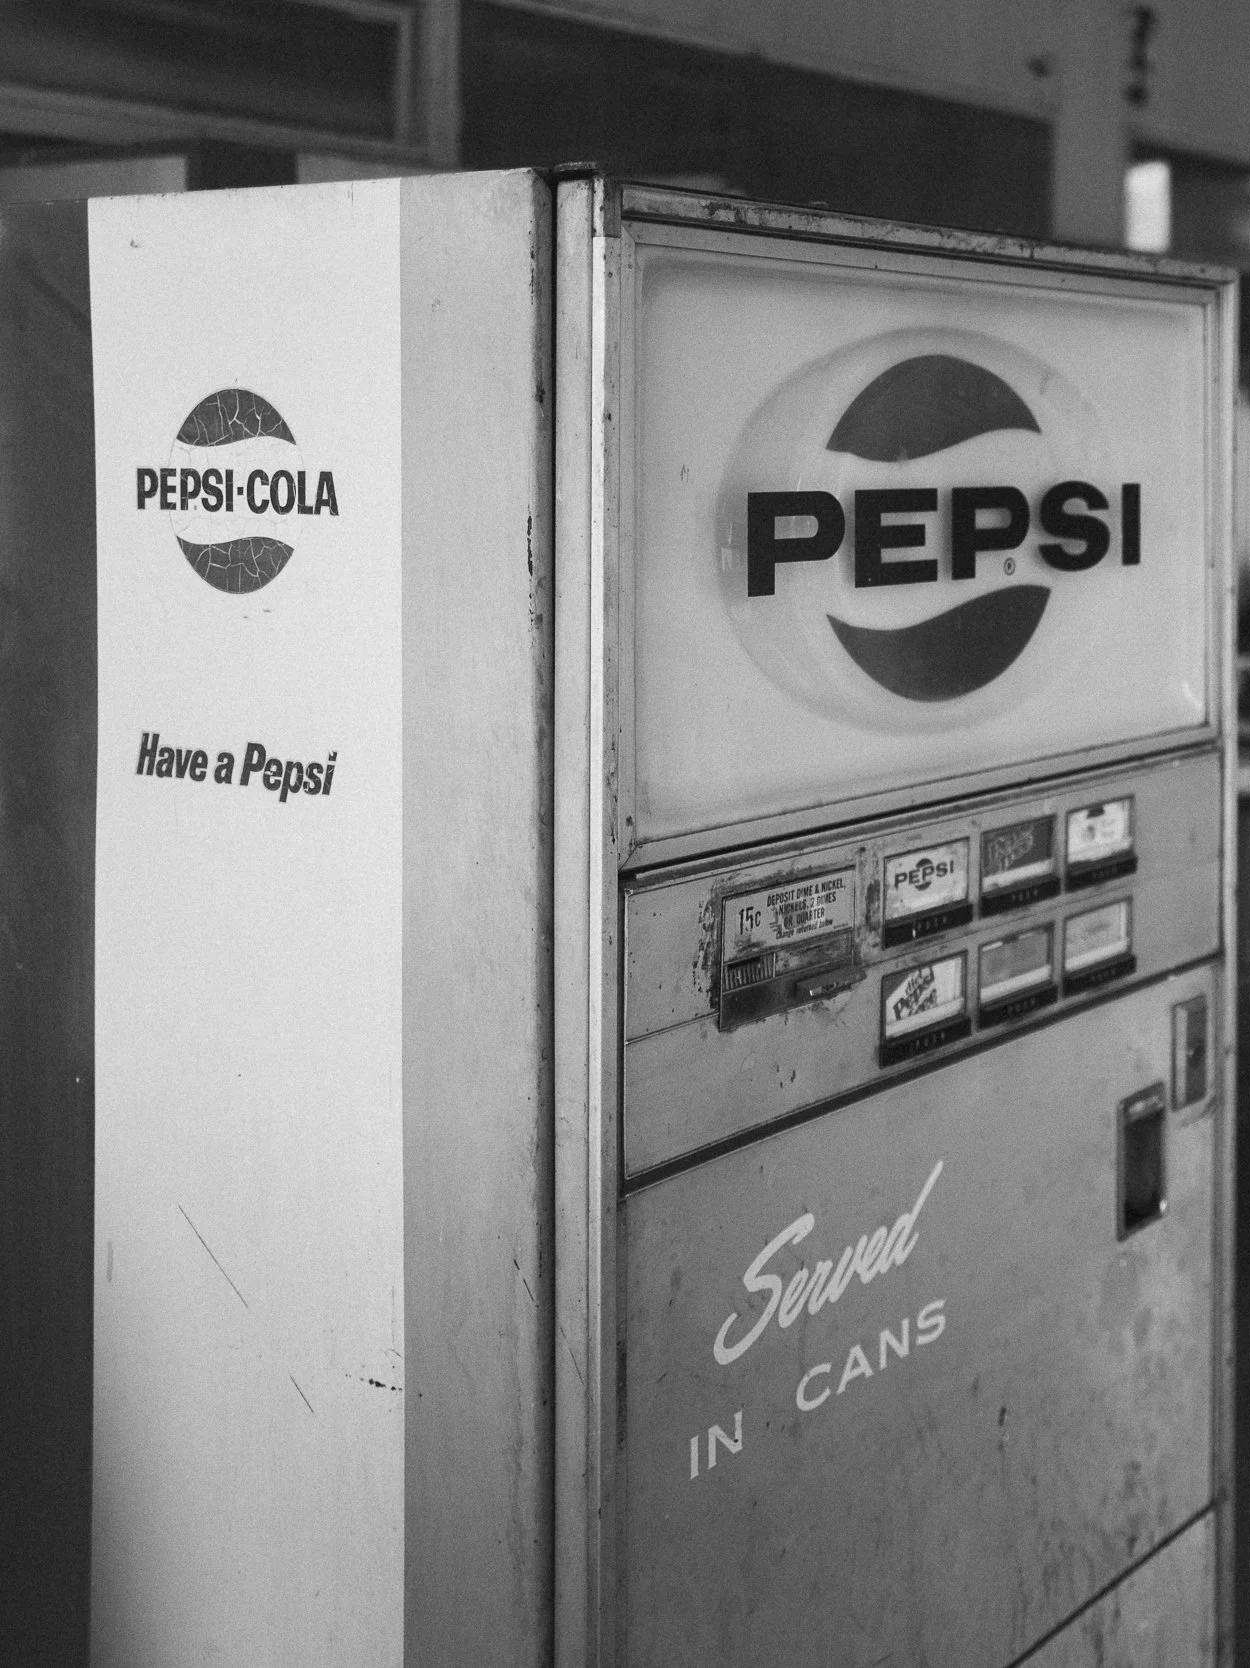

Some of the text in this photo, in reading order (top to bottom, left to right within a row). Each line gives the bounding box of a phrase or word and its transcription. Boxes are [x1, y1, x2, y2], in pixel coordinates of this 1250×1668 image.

[747, 480, 1141, 597] PEPSI
[136, 731, 338, 803] Have a Pepsi
[767, 890, 795, 907] DEPOSIT
[814, 883, 820, 894] &
[894, 859, 954, 890] PEPSI
[796, 907, 825, 924] QUARTER
[713, 1160, 943, 1365] Served
[690, 1300, 947, 1479] IN CANS
